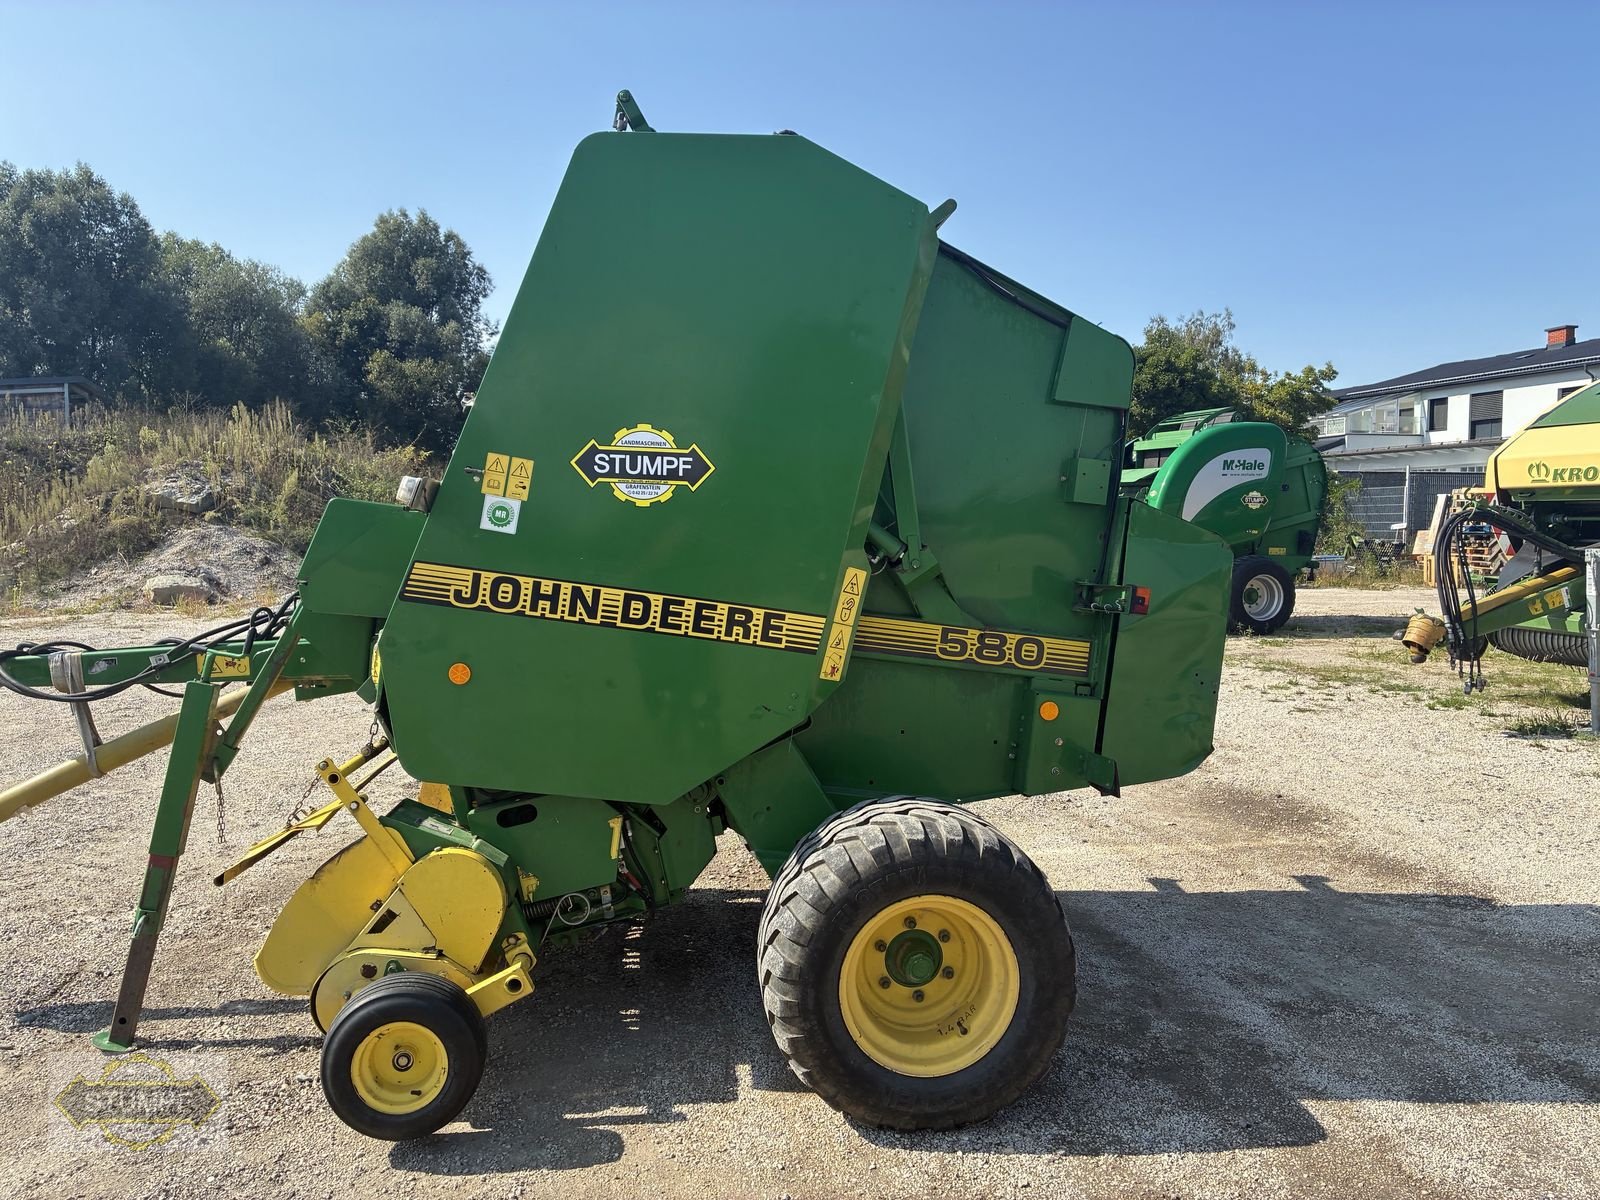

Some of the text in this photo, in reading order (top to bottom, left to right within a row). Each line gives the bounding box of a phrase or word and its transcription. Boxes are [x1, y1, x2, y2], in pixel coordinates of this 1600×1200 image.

[593, 453, 693, 477] STUMPF
[1222, 459, 1265, 471] McHale
[1552, 466, 1600, 482] KRO
[495, 509, 507, 519] MR
[451, 571, 786, 648] JOHN DEERE
[937, 626, 1047, 669] 580
